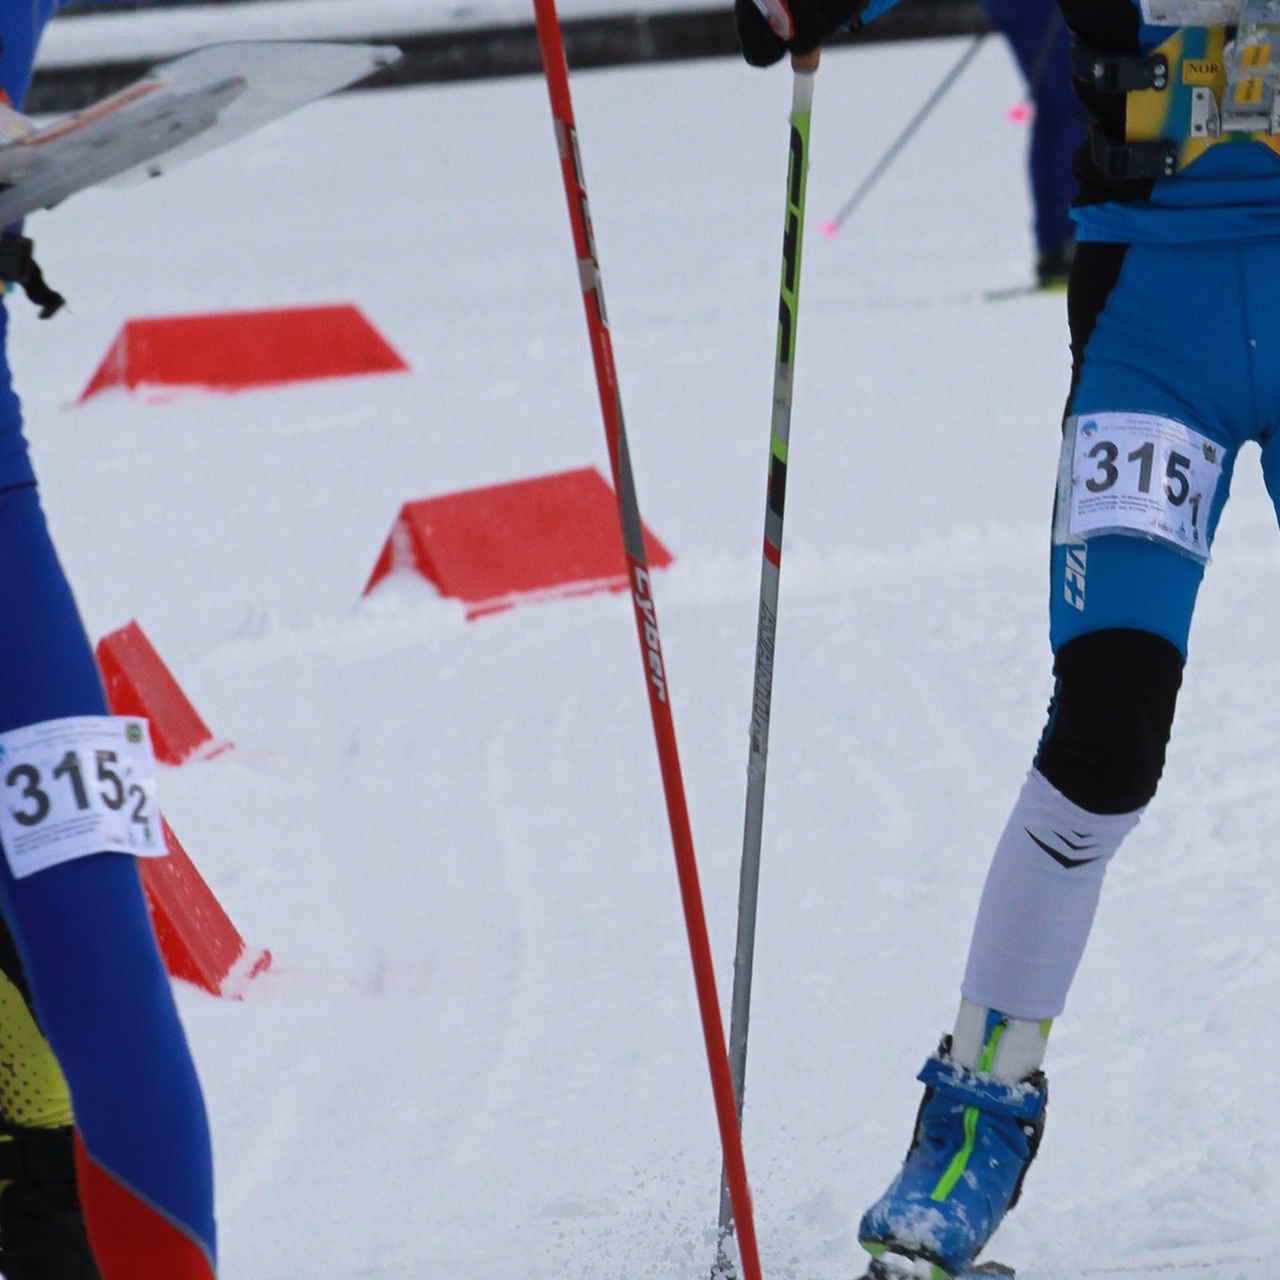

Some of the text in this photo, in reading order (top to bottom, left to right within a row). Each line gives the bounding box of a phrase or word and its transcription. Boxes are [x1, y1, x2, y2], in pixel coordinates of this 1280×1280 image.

[1085, 440, 1190, 507] 315
[6, 749, 150, 827] 315 2
